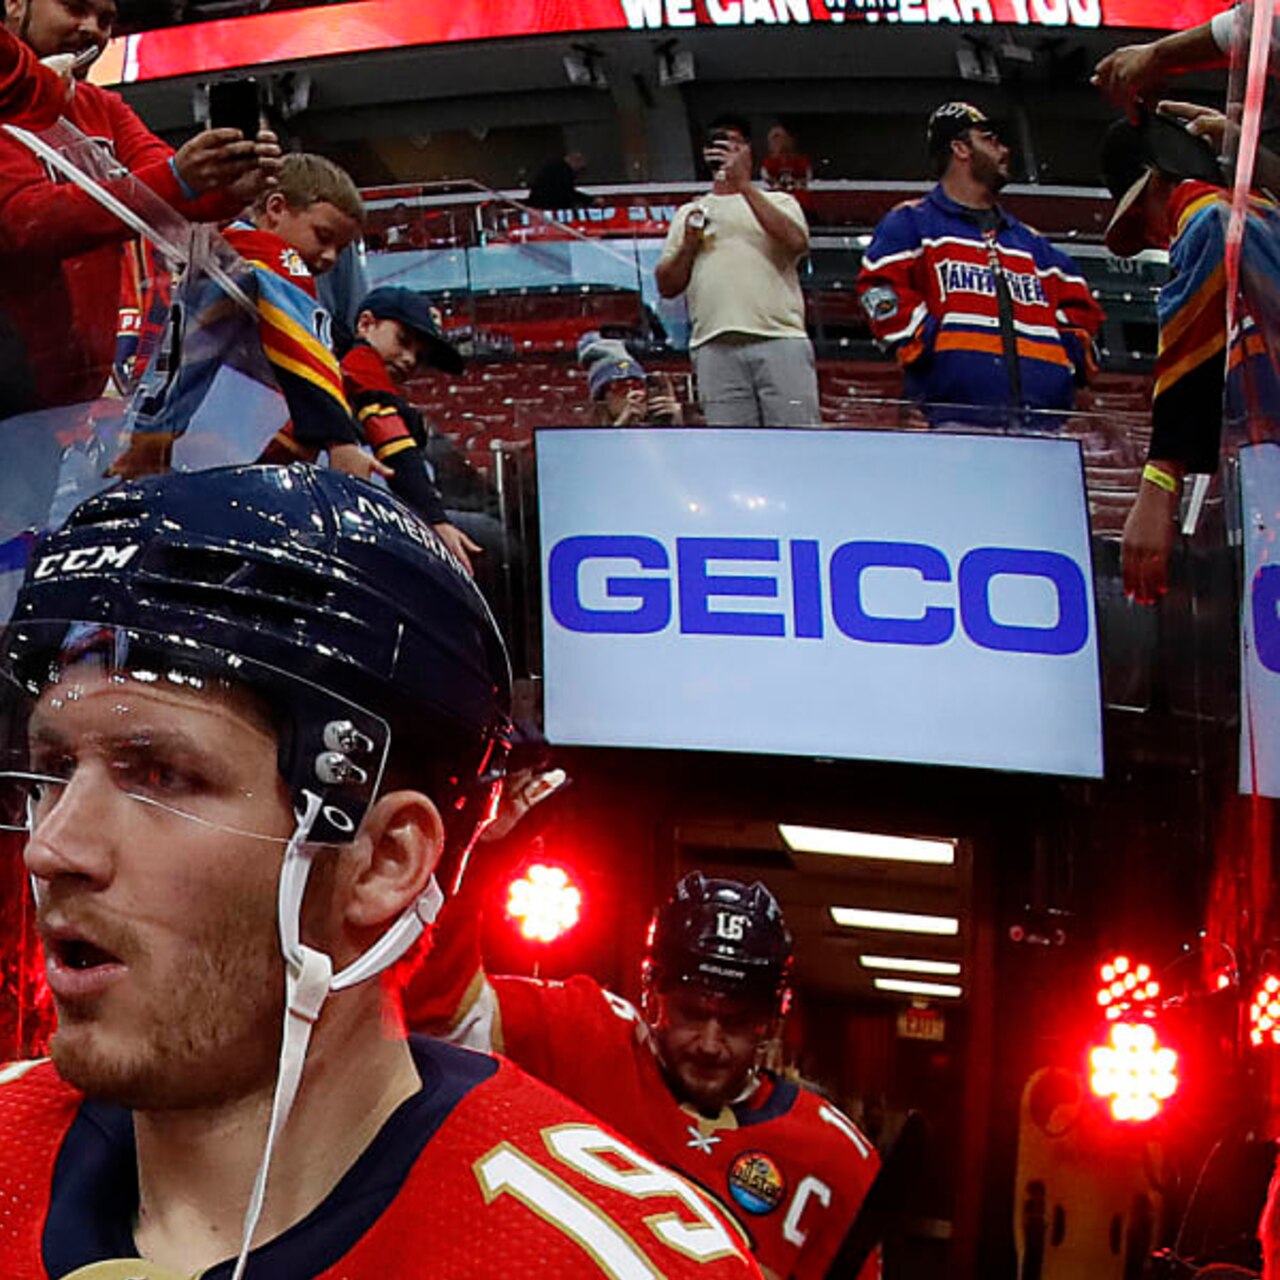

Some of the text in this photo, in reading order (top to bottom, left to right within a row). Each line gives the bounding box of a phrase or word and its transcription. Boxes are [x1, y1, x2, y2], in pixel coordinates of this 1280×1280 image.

[33, 543, 139, 579] CCM
[548, 534, 1091, 656] GEICO
[782, 1175, 832, 1248] C
